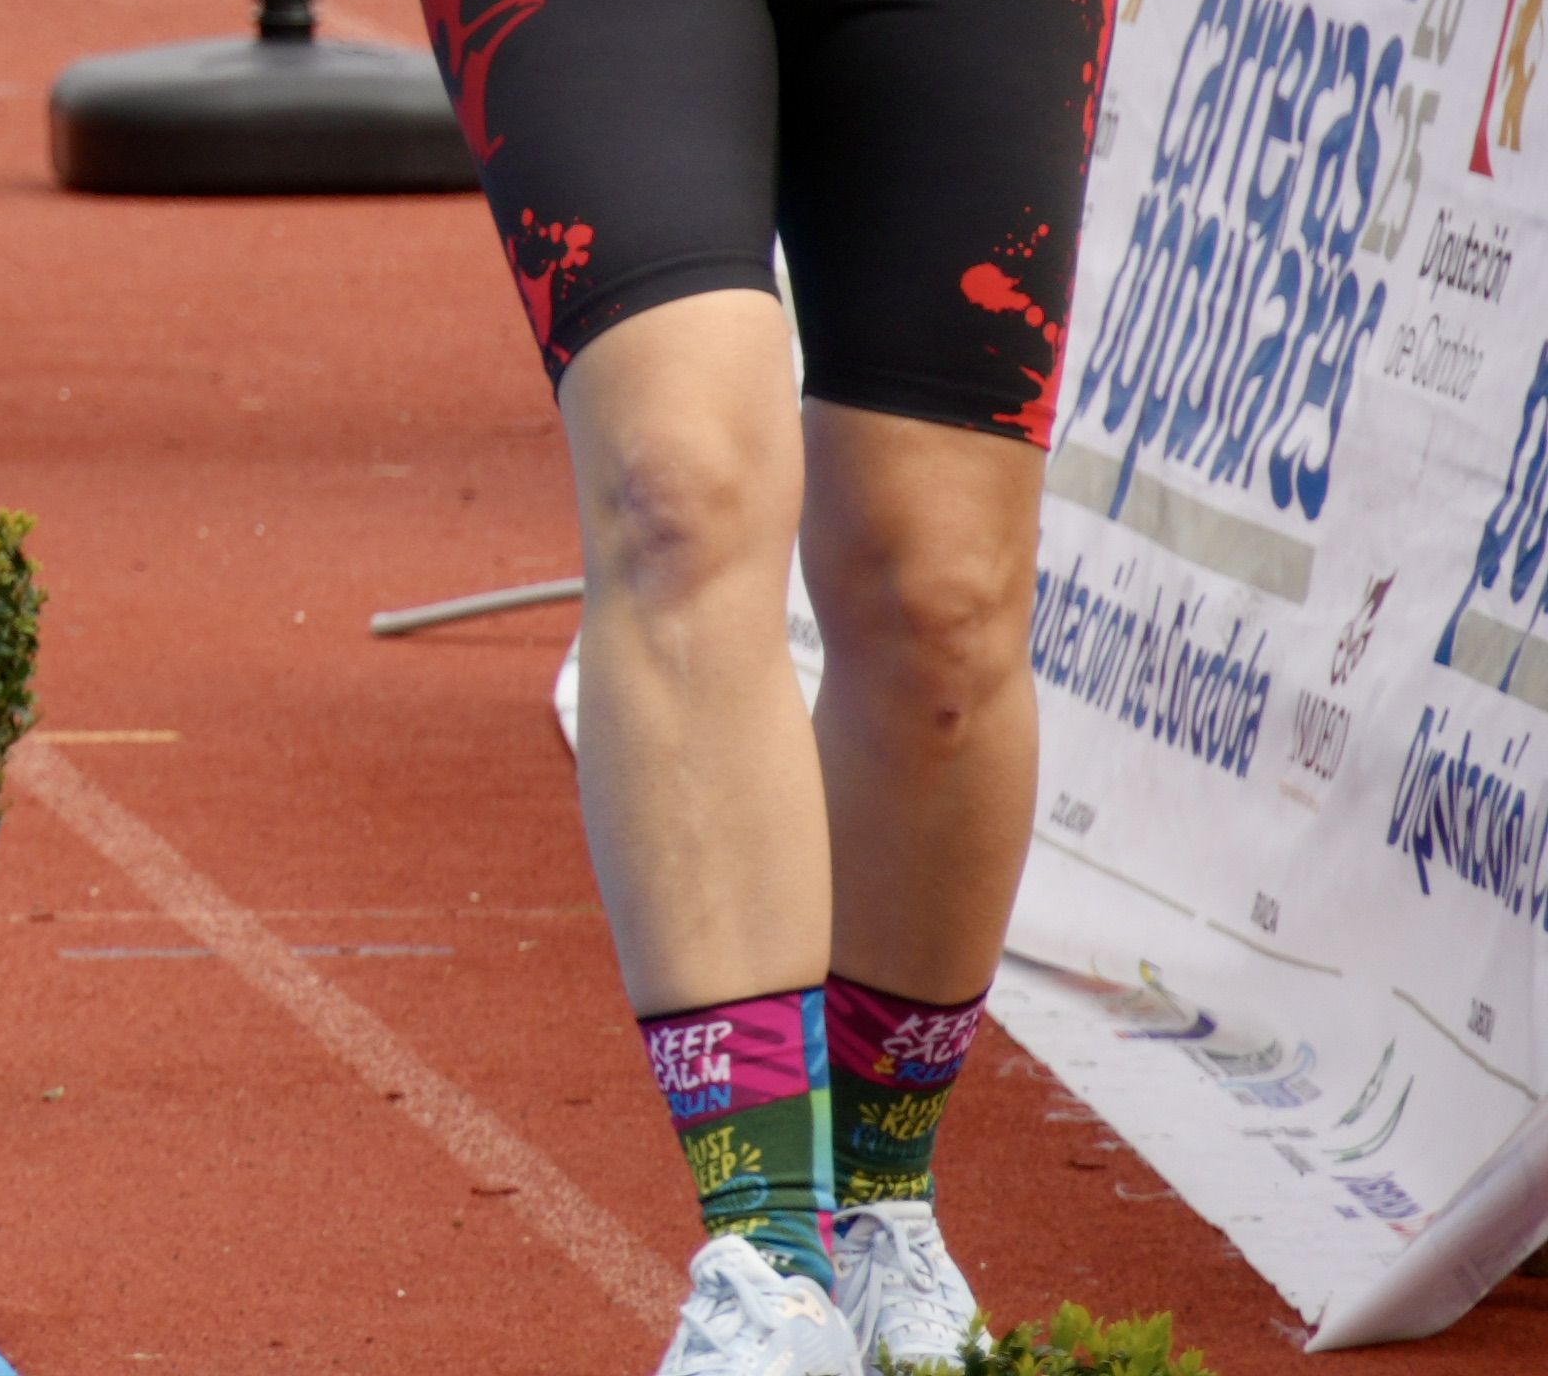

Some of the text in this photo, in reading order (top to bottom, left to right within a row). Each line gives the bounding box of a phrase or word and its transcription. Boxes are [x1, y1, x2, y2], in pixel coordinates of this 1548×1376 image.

[1418, 208, 1513, 304] Diputación
[1058, 194, 1388, 522] populares
[1154, 591, 1271, 779] Córdoba
[649, 1020, 734, 1060] KEEP
[669, 1084, 733, 1120] RUN
